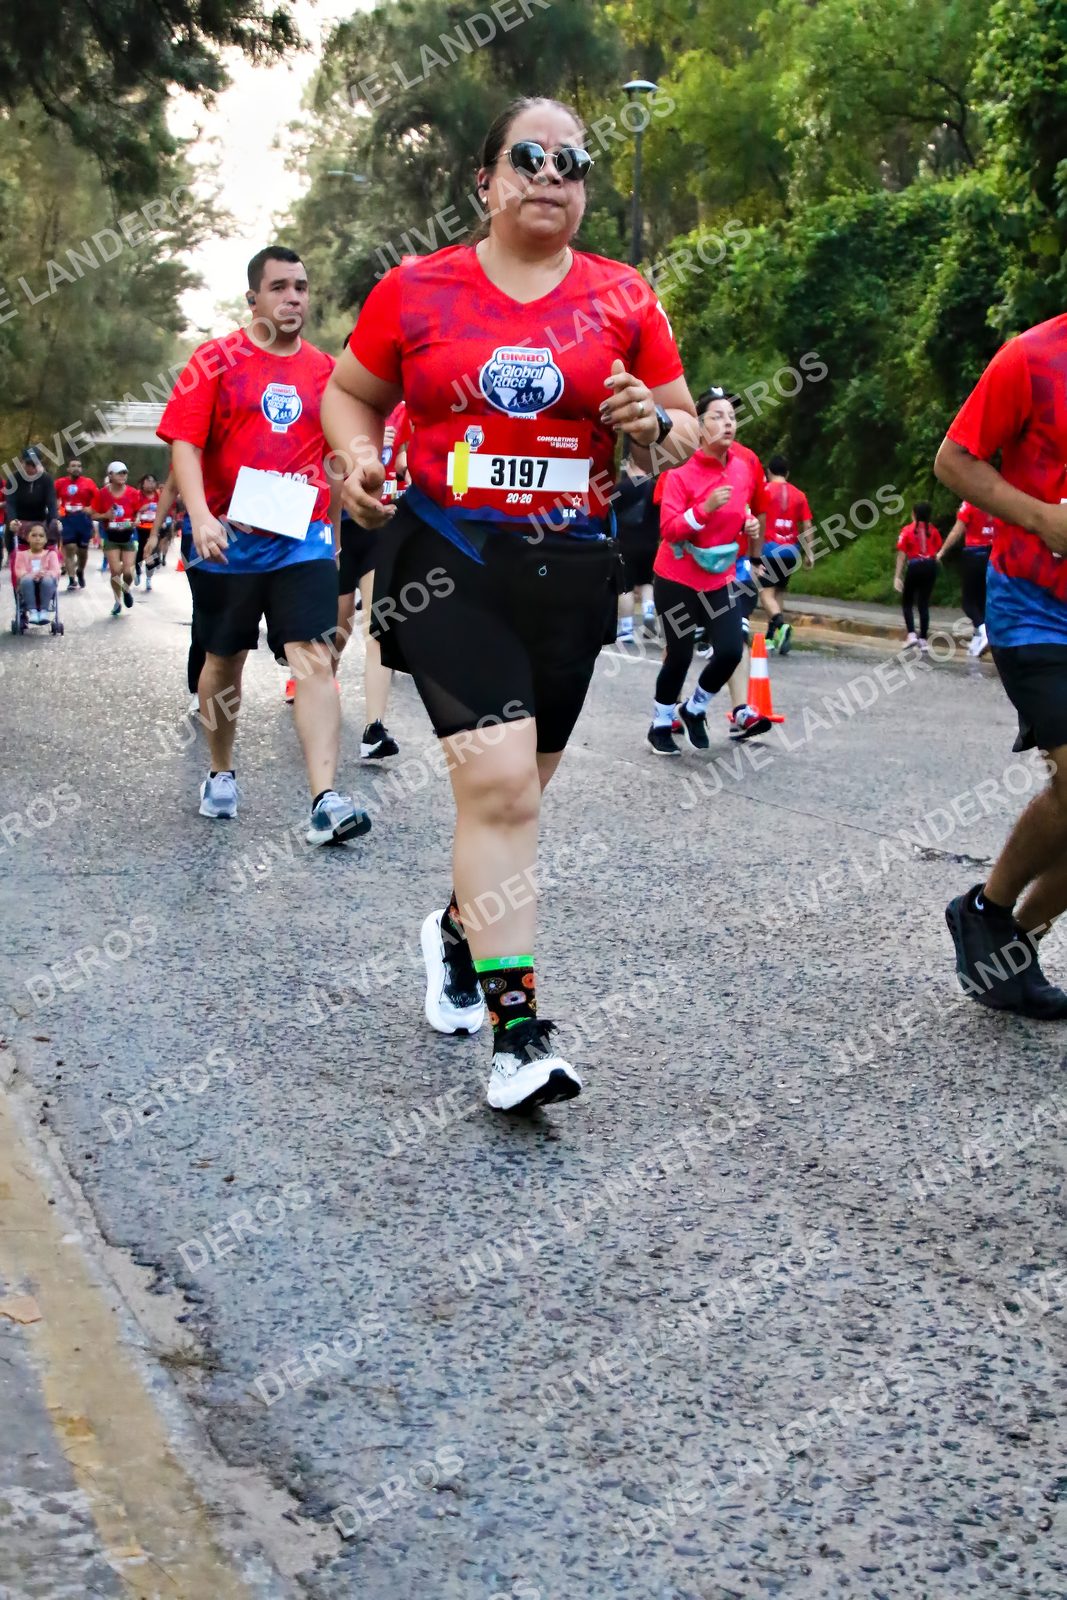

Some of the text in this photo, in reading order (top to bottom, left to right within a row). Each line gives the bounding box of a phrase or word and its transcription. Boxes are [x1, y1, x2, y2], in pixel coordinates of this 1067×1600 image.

[501, 353, 545, 362] BIMBO
[501, 365, 544, 379] Global
[493, 375, 527, 388] Race
[490, 457, 549, 488] 3197
[562, 508, 577, 518] 5K
